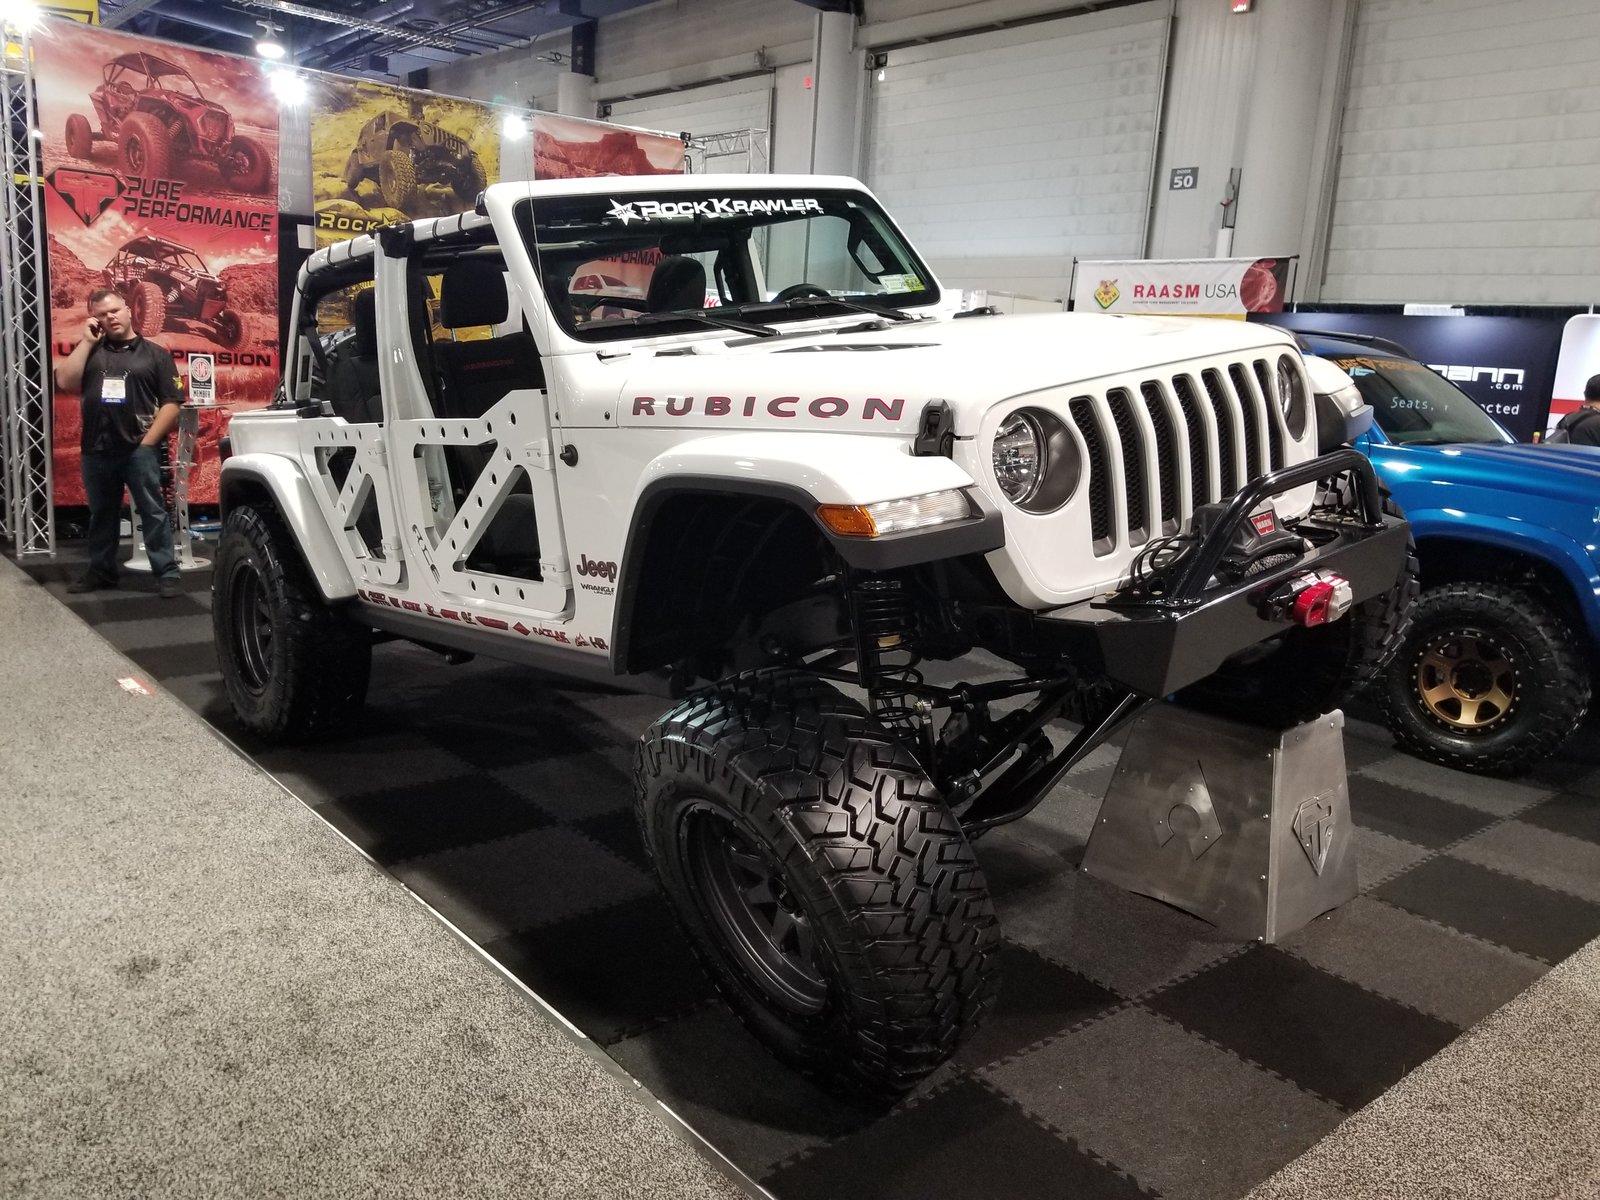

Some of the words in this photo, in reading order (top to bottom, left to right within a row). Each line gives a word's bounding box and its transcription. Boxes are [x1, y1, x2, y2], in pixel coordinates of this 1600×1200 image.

[125, 177, 185, 201] PURE
[1174, 175, 1193, 188] 50
[124, 197, 274, 232] PERFORMANCE
[633, 198, 823, 217] ROCKKRAWLER
[318, 212, 379, 231] ROCK
[1133, 284, 1200, 298] RAASM
[1205, 284, 1237, 298] USA
[632, 396, 904, 420] RUBICON
[576, 553, 617, 583] Jeep
